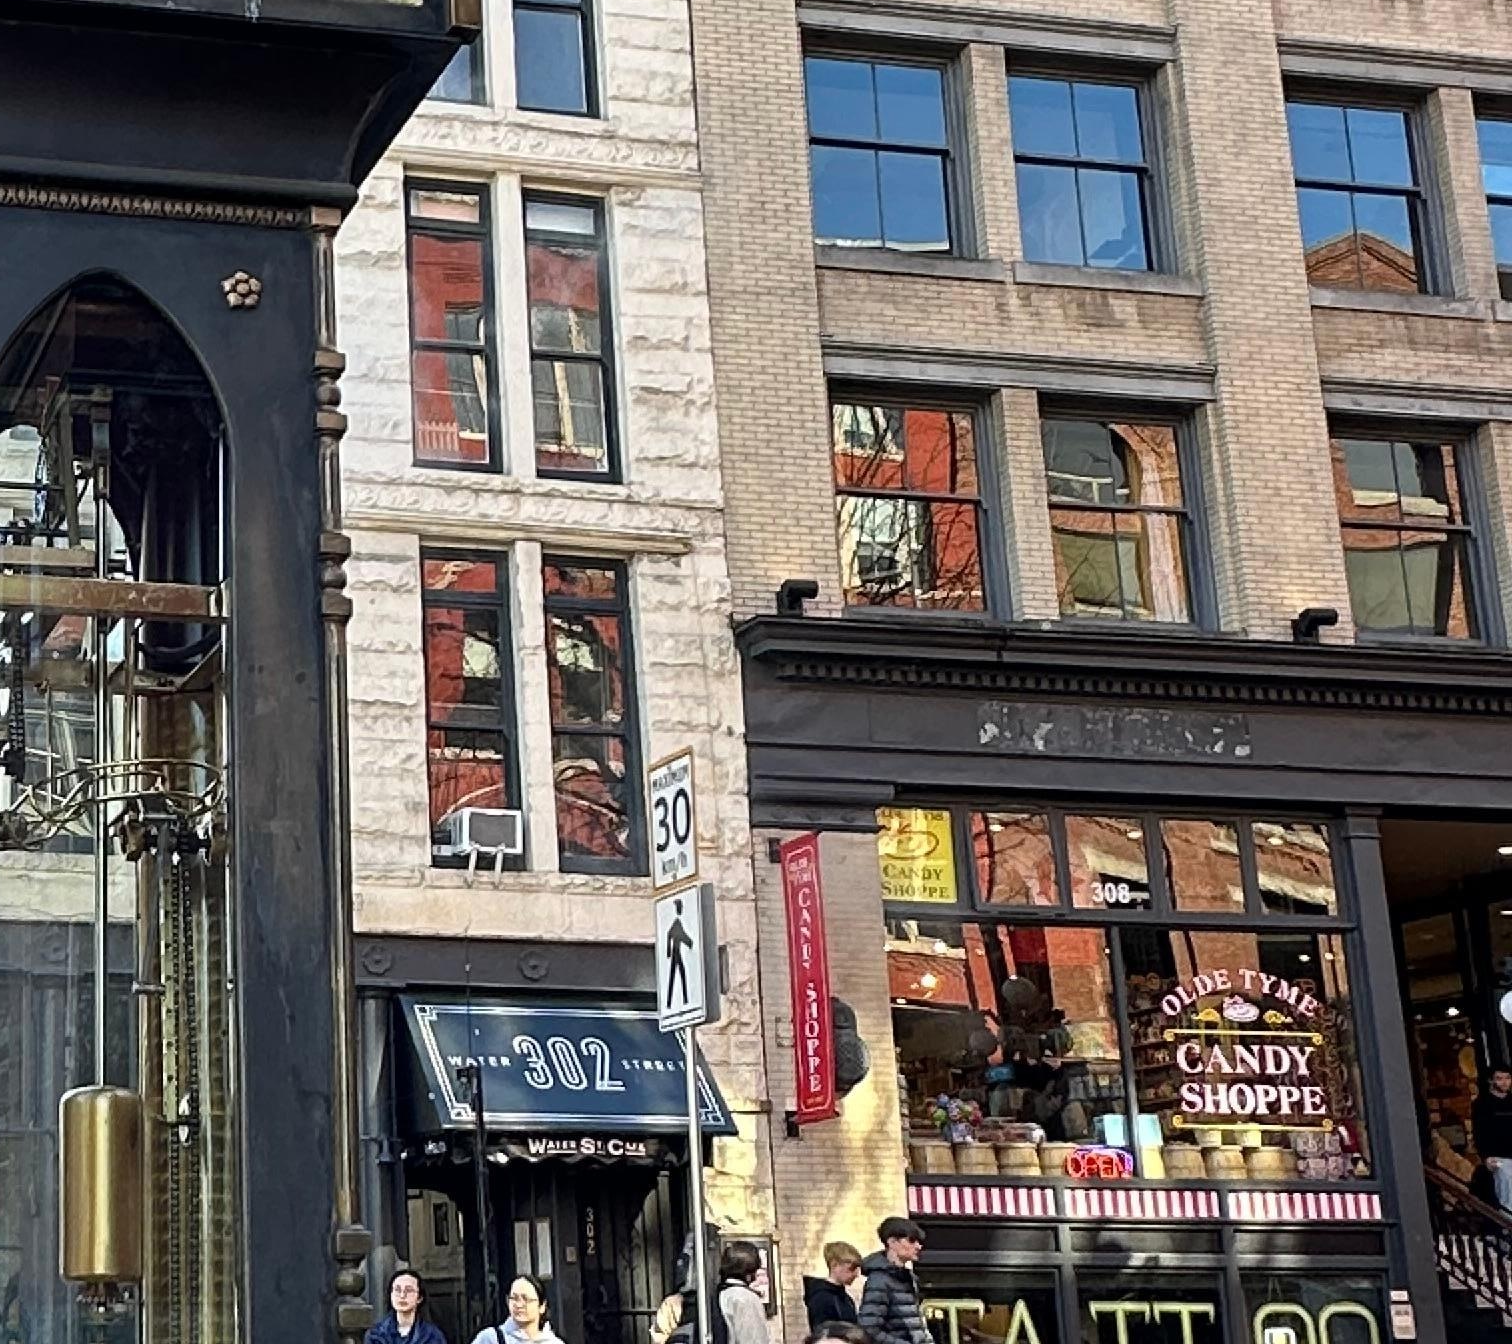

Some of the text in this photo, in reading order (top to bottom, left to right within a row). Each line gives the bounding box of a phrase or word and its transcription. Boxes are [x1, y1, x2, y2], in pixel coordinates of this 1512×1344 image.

[655, 788, 691, 852] 30
[883, 862, 944, 881] CANDY
[1090, 881, 1130, 904] 308
[1161, 968, 1320, 1016] OLDE TYME
[447, 1055, 512, 1067] WATER
[512, 1034, 626, 1092] 302
[1176, 1042, 1316, 1076] CANDY
[1180, 1083, 1326, 1115] SHOPPE
[586, 1206, 595, 1255] 302
